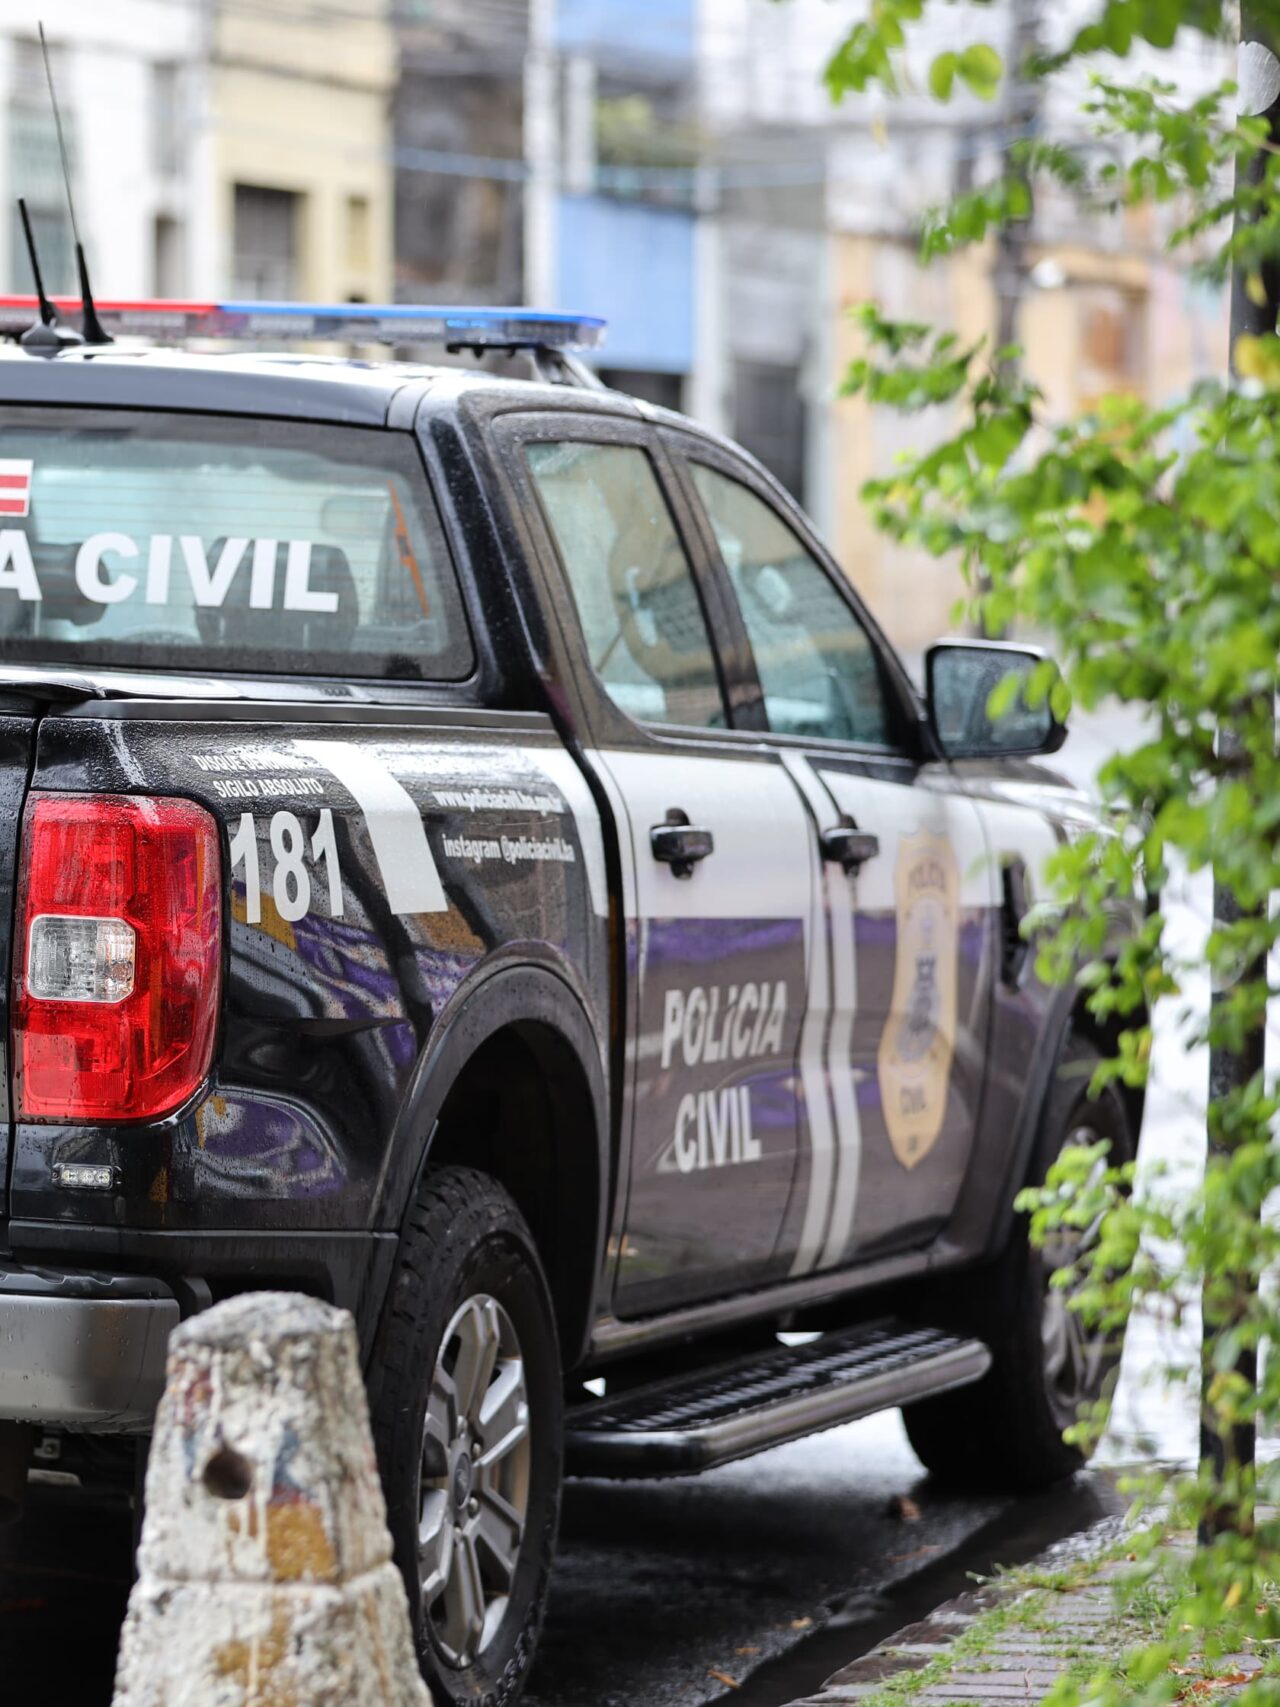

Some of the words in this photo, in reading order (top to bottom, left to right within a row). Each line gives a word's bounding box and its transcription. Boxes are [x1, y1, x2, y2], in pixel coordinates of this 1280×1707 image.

[75, 532, 339, 613] CIVIL
[213, 779, 259, 798] SIGILO
[258, 777, 324, 797] ABSOLUTO
[230, 808, 344, 924] 181
[442, 833, 502, 864] instagram
[661, 981, 787, 1069] POLÍCIA
[674, 1084, 761, 1173] CIVIL
